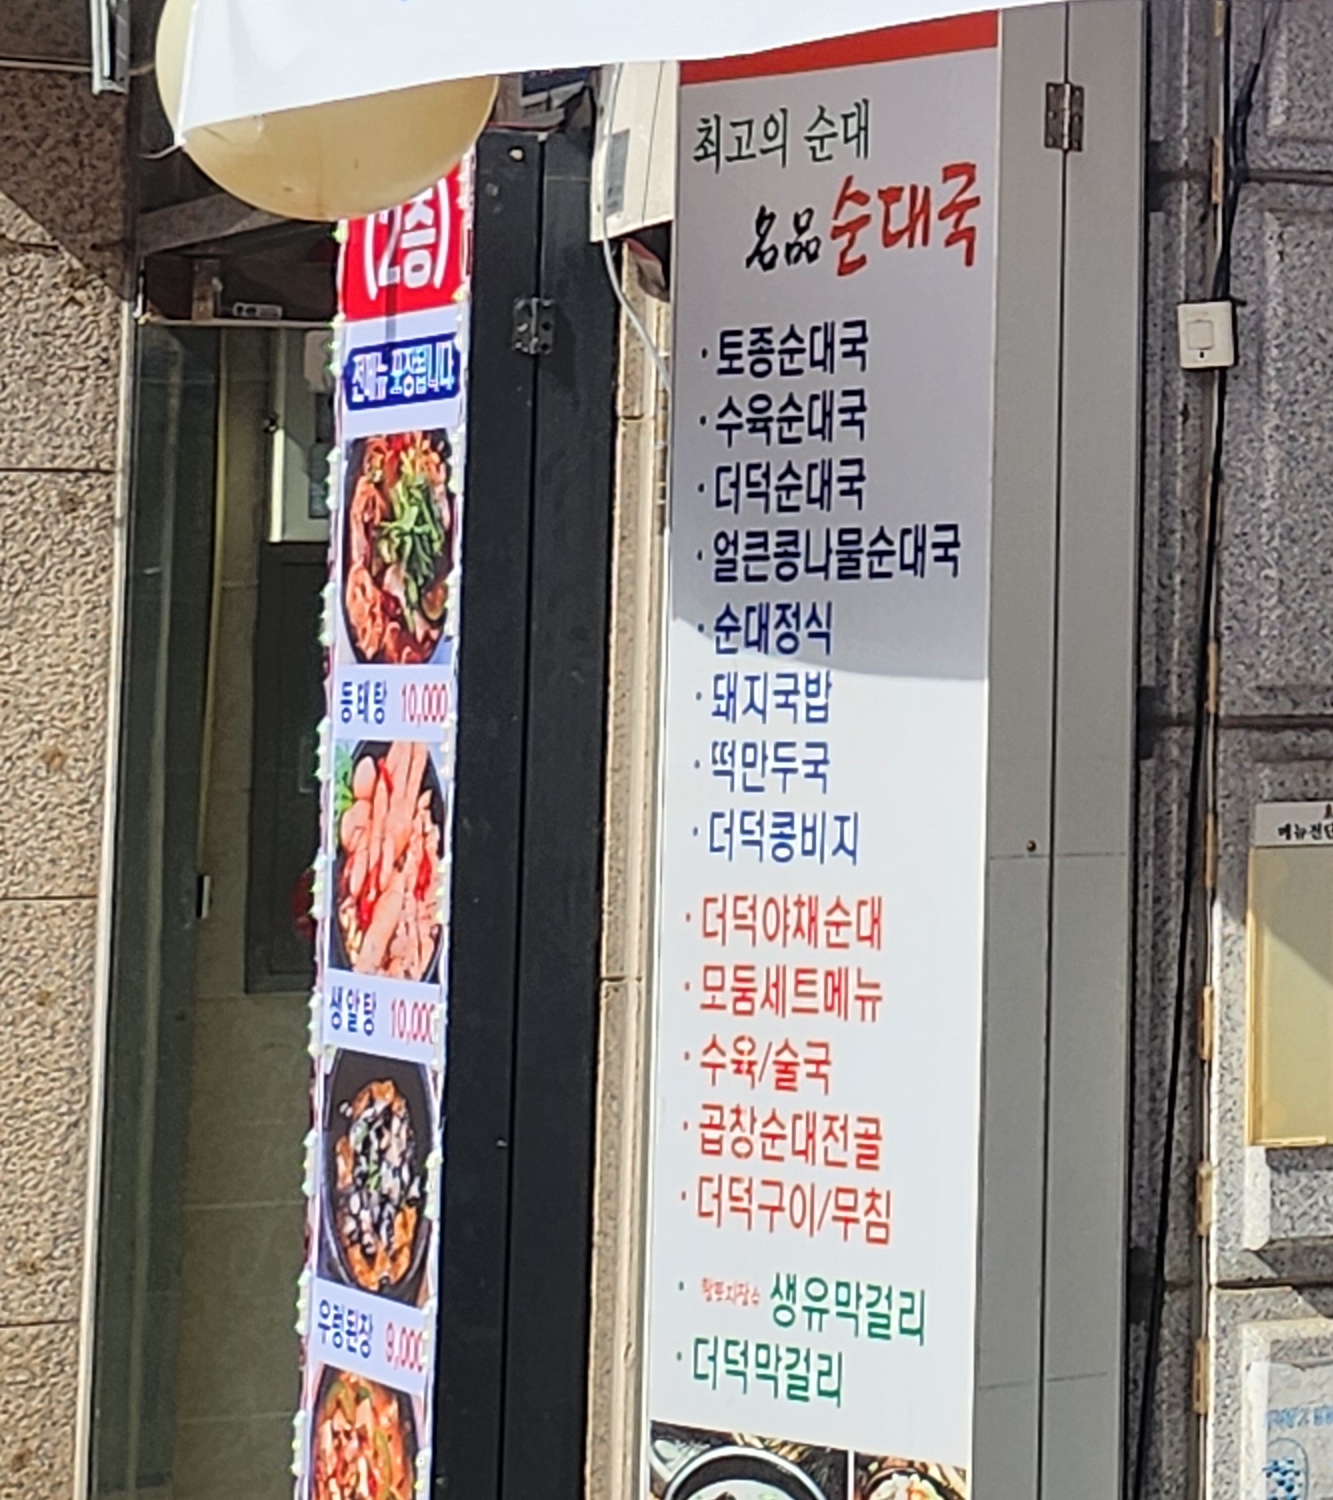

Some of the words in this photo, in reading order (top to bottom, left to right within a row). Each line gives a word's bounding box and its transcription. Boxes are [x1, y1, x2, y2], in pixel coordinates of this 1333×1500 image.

[693, 107, 789, 173] 최고의
[803, 98, 870, 163] 순대
[745, 205, 822, 273] 名品
[830, 162, 981, 277] 순대국
[717, 319, 869, 380] 토종순대국
[715, 387, 868, 449] 수육순대국
[714, 457, 867, 515] 더덕순대국
[713, 523, 961, 584] 얼큰콩나물순대국
[713, 601, 833, 656] 순대정식
[401, 682, 449, 728] 10,000
[711, 670, 833, 725] 돼지국밥
[711, 739, 831, 795] 떡만두국
[709, 809, 860, 867] 더덕콩비지
[702, 894, 883, 951] 더덕야채순대
[700, 963, 883, 1023] 모둠세트메뉴
[700, 1033, 832, 1096] 수육/술국
[699, 1103, 883, 1172] 곱창순대전골
[697, 1173, 892, 1246] 더덕구이/무침
[769, 1272, 926, 1347] 생유막걸리
[693, 1336, 843, 1409] 더덕막걸리
